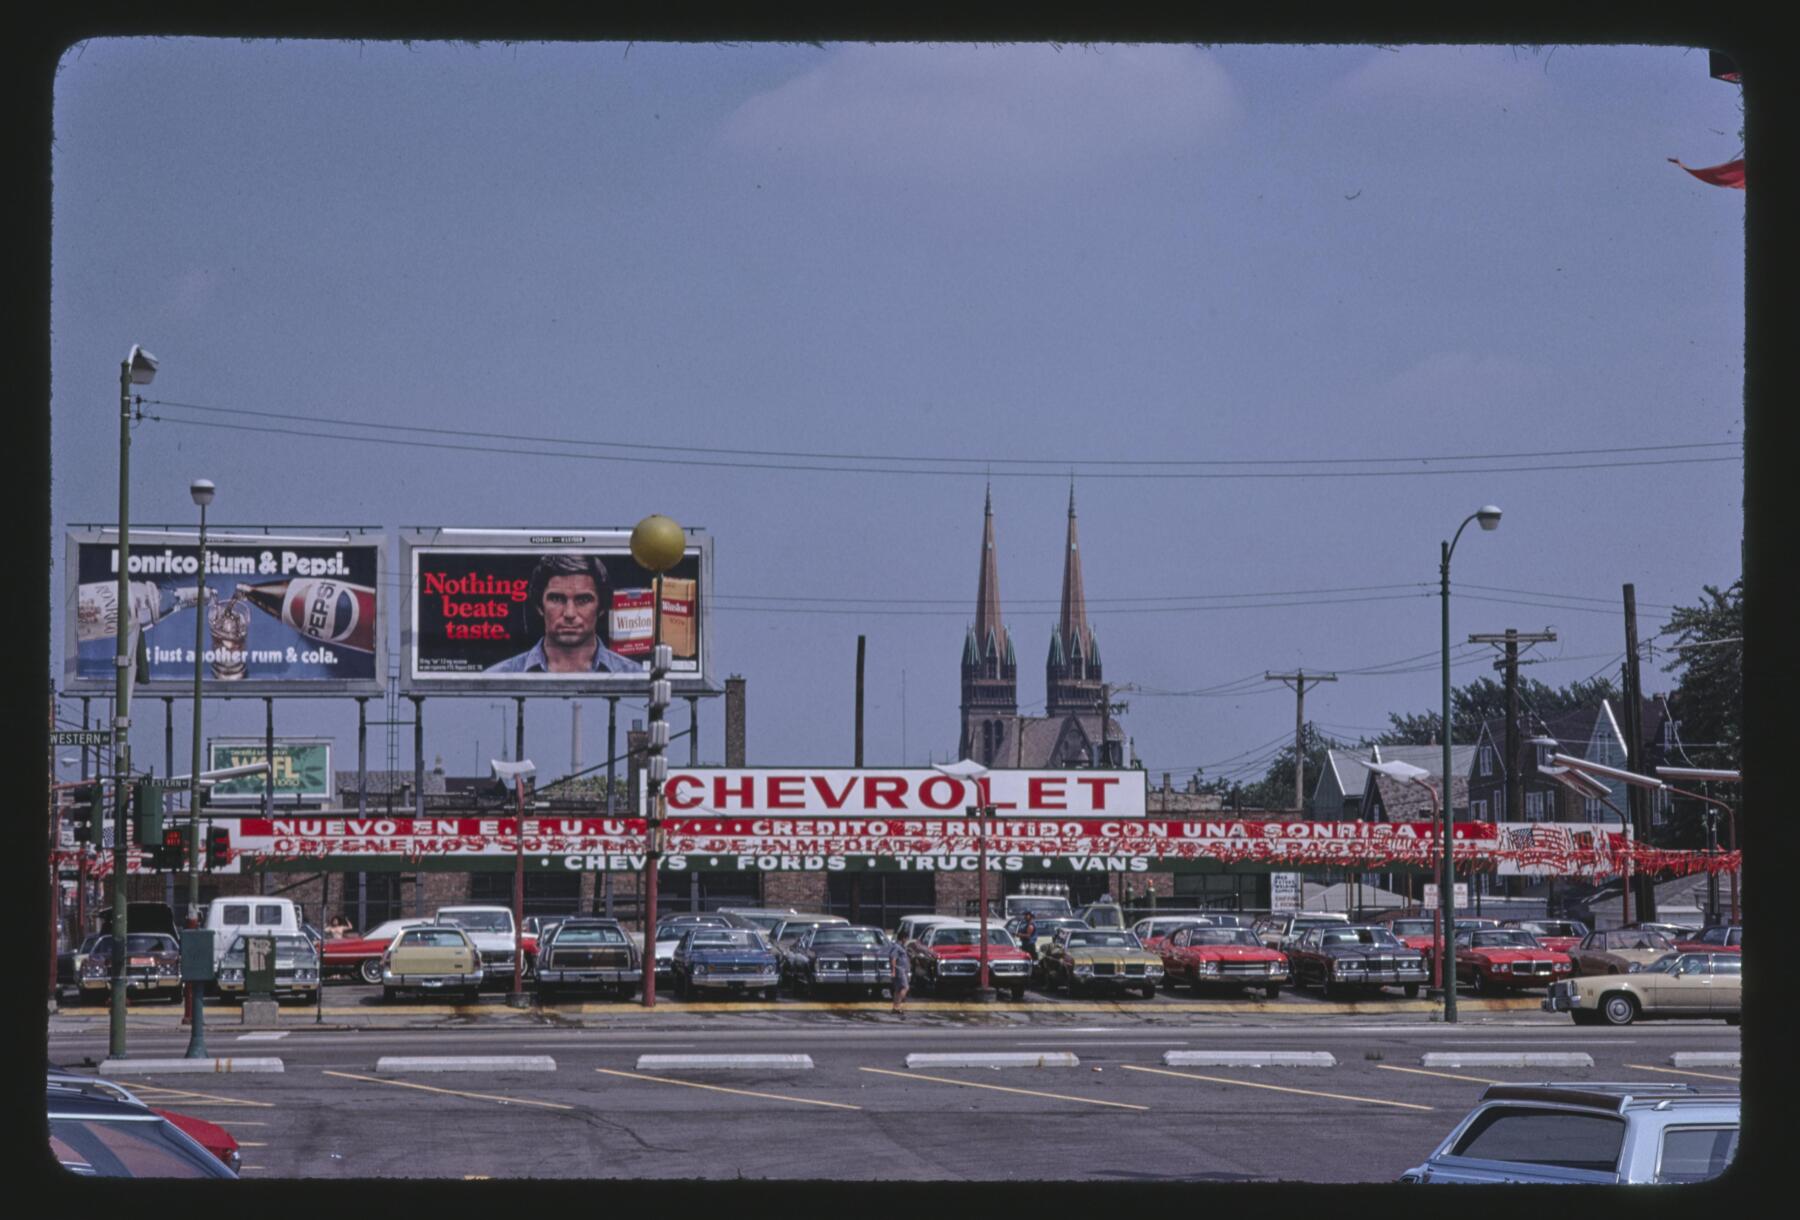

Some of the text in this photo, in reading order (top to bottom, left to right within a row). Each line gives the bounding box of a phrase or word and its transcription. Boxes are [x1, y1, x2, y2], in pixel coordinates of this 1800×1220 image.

[259, 551, 277, 574] &
[282, 551, 350, 575] Pepsi.
[423, 572, 529, 602] Nothing
[307, 582, 336, 638] PEPSI
[441, 594, 509, 618] beats
[445, 620, 511, 640] taste.
[616, 615, 652, 630] Winston
[154, 646, 182, 665] just
[252, 650, 282, 663] rum
[285, 647, 297, 663] &
[301, 647, 338, 663] cola.
[50, 733, 101, 744] WESTERN
[664, 775, 1119, 810] CHEVROLET
[273, 820, 397, 835] NUEVO
[412, 820, 459, 834] EN
[752, 821, 888, 836] CREDITO
[904, 821, 1083, 837] PERMITIDO
[1101, 822, 1168, 837] CON
[1182, 822, 1249, 838] UNA
[736, 855, 847, 870] FORDS
[895, 856, 1024, 871] TRUCKS
[1069, 857, 1148, 871] VANS
